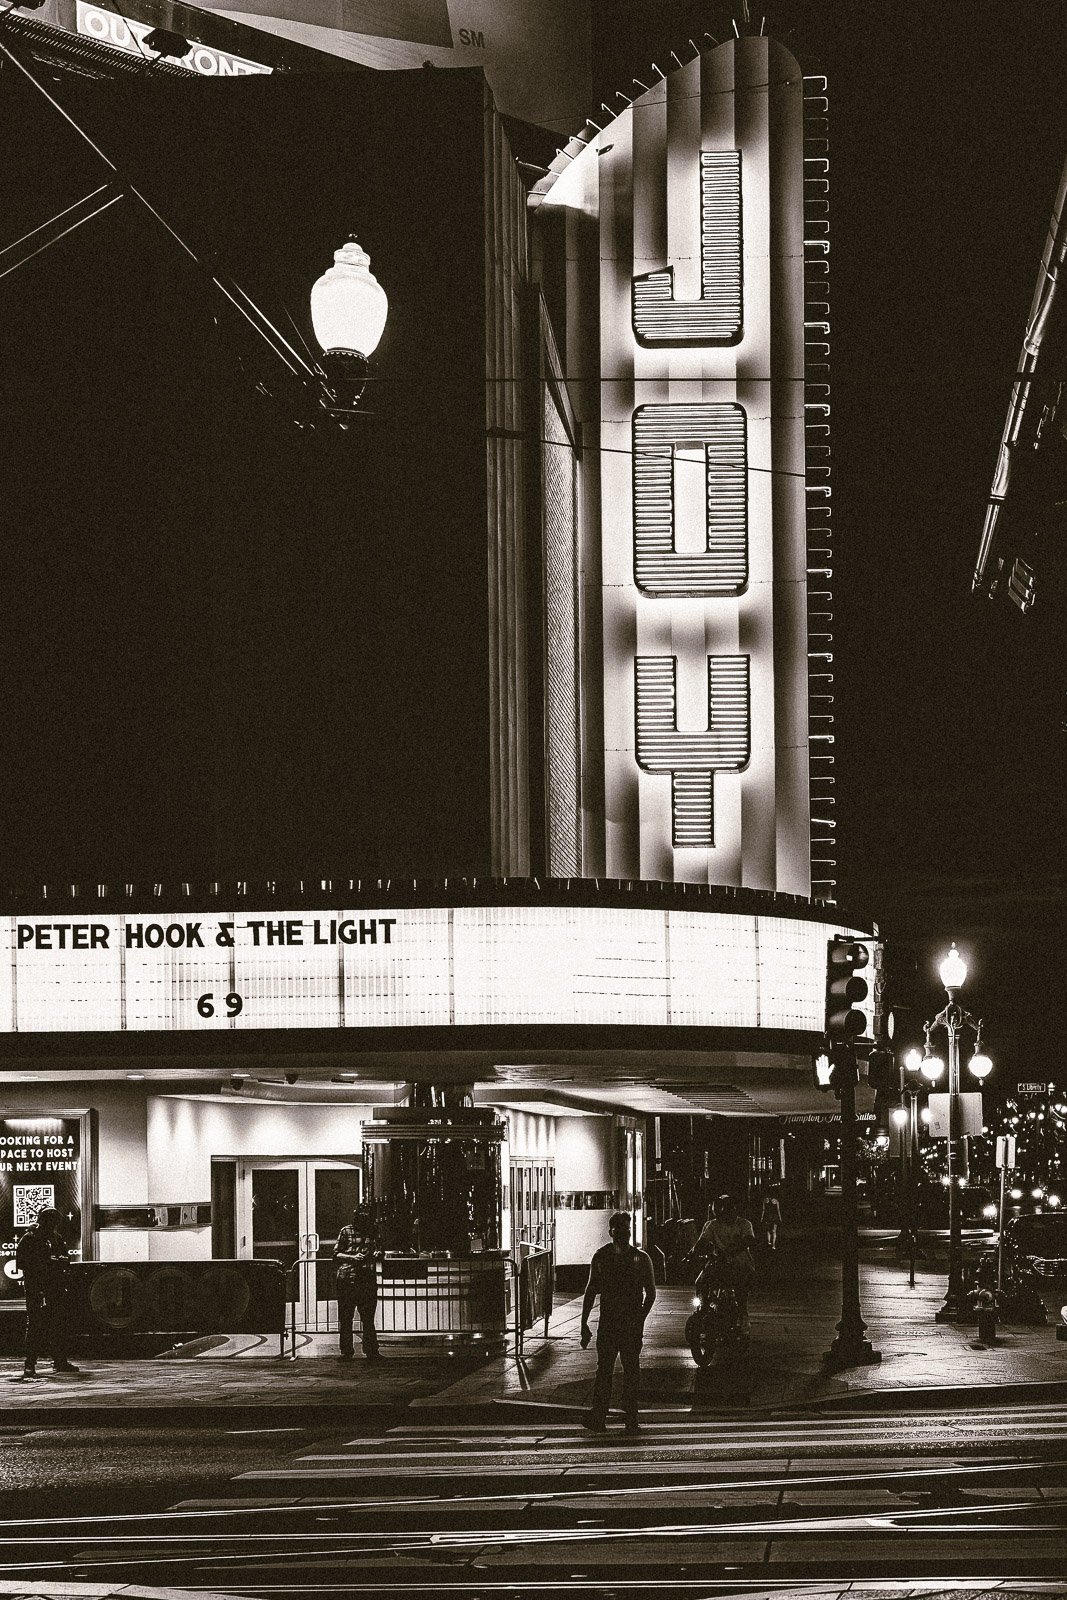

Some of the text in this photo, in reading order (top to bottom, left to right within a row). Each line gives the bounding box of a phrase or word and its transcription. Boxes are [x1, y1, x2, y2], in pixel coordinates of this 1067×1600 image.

[458, 28, 485, 48] SM
[631, 149, 751, 848] JOY
[17, 918, 397, 950] PETER HOOK & THE LIGHT
[855, 1112, 877, 1121] Suites
[43, 1135, 64, 1145] FOR
[66, 1135, 75, 1145] A
[30, 1148, 44, 1158] TO
[46, 1148, 74, 1158] HOST
[16, 1161, 43, 1172] NEXT
[45, 1161, 77, 1171] EVENT
